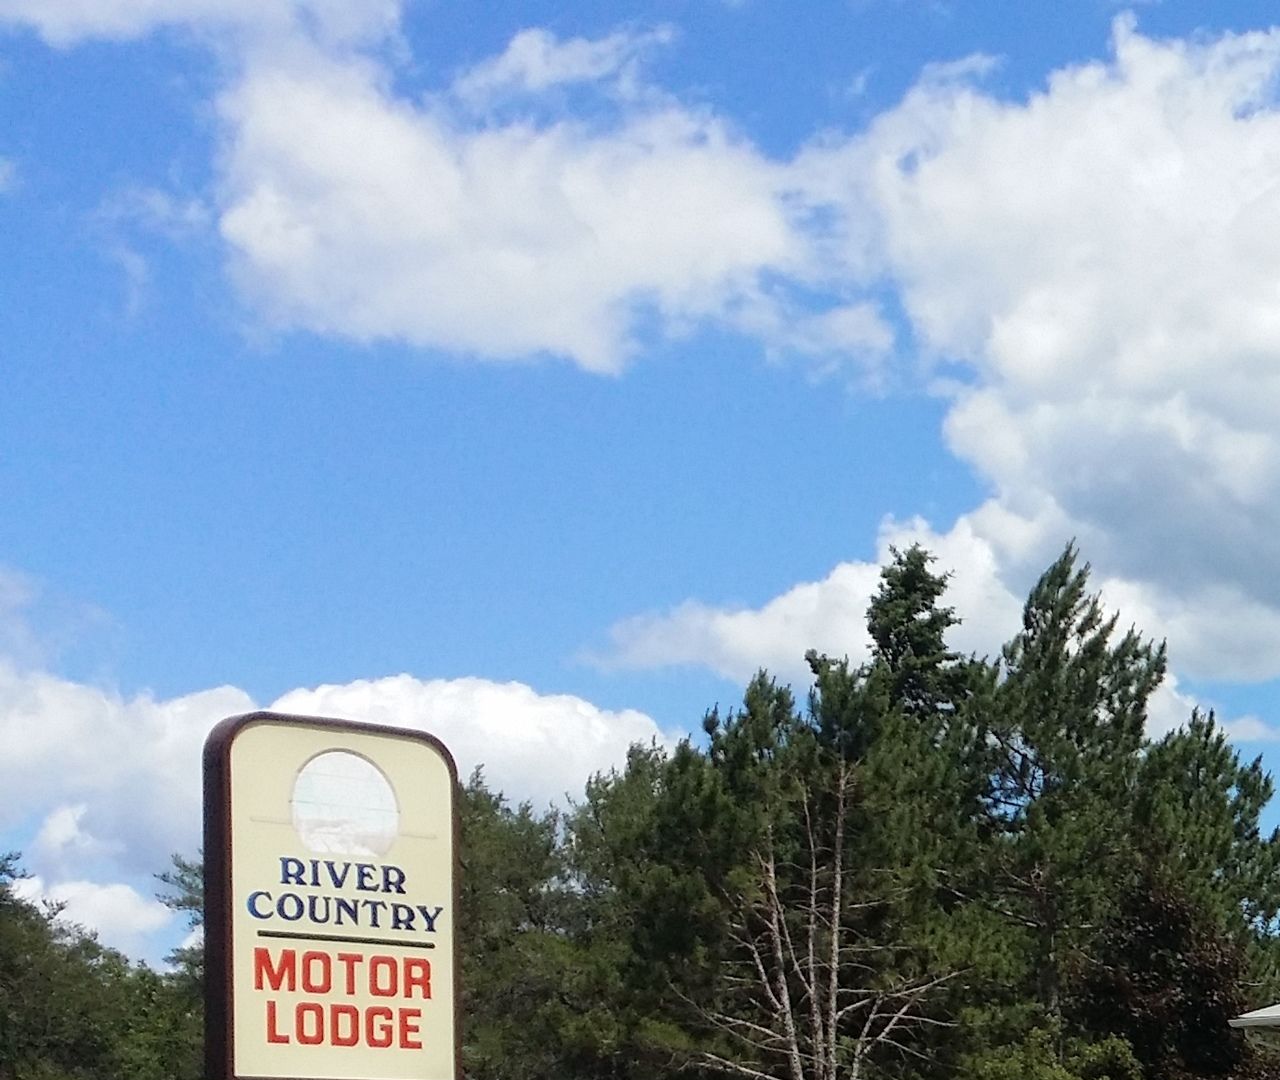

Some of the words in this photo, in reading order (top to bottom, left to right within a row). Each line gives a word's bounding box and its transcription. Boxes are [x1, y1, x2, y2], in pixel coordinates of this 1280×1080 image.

[279, 857, 406, 894] RIVER
[247, 891, 443, 932] COUNTRY
[254, 947, 432, 999] MOTOR
[267, 1000, 422, 1049] LODGE
